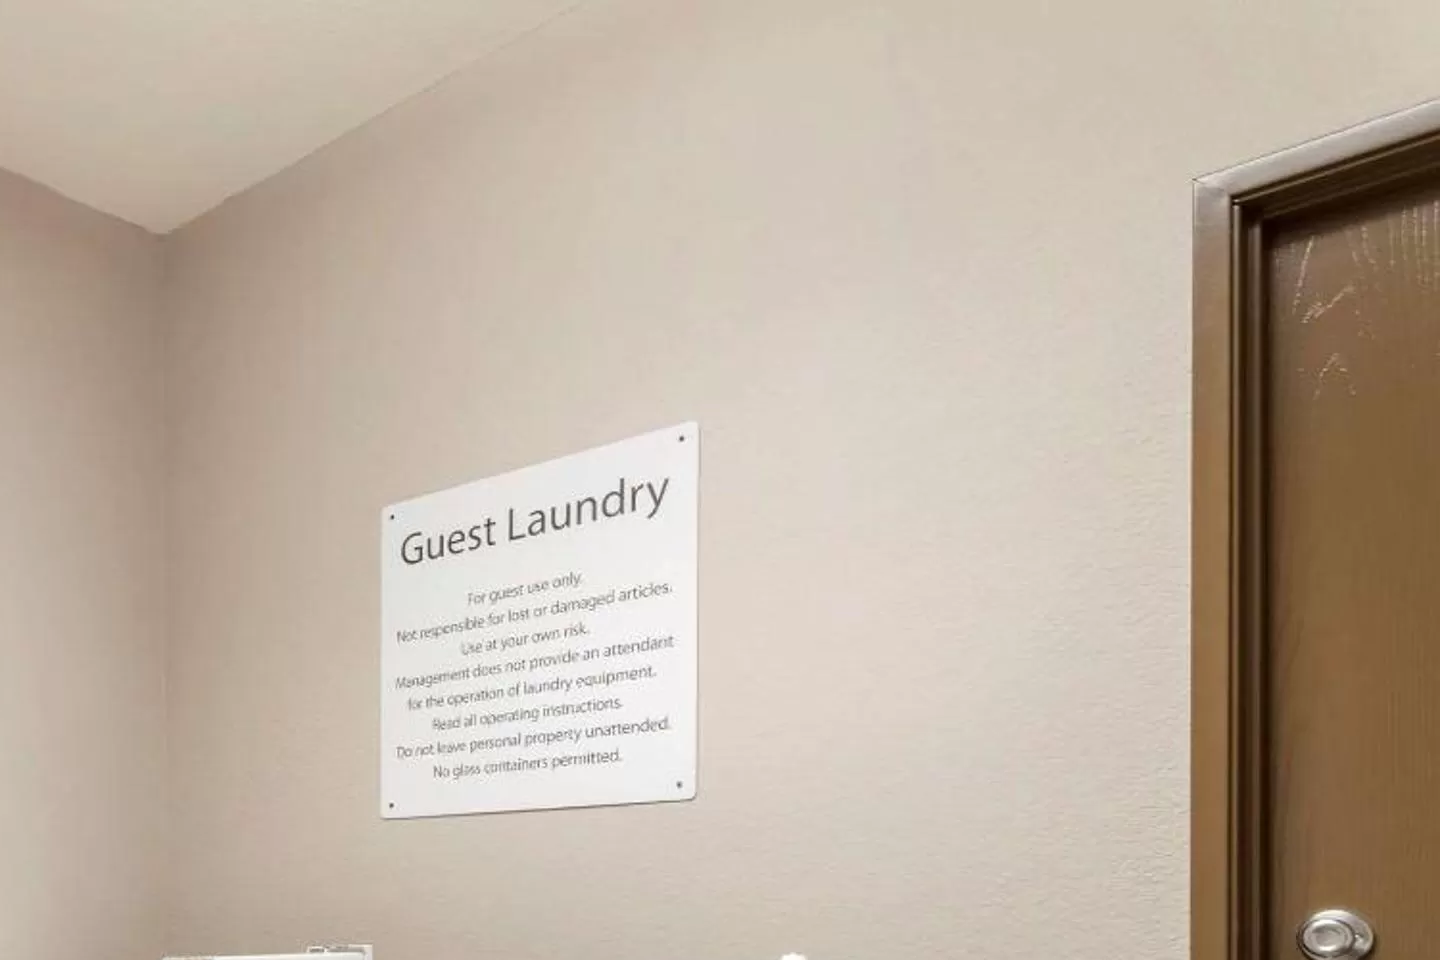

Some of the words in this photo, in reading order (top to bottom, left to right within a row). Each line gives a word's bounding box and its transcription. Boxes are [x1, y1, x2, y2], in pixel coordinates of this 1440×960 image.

[400, 517, 497, 566] Guest
[508, 477, 670, 541] Laundry
[396, 629, 418, 642] Not
[420, 617, 485, 639] responsible
[487, 612, 506, 625] for
[508, 608, 529, 622] lost
[533, 605, 548, 617] or
[550, 590, 615, 615] damaged
[617, 581, 673, 602] articles.
[467, 593, 487, 605] For
[489, 585, 524, 605] guest
[527, 580, 549, 594] use
[461, 642, 482, 655] Use
[485, 639, 498, 652] at
[500, 634, 529, 652] your
[531, 628, 560, 643] own
[563, 621, 590, 638] risk.
[395, 668, 470, 689] Management
[472, 664, 502, 678] does
[505, 659, 526, 672] not
[529, 648, 580, 672] provide
[583, 648, 600, 661] an
[602, 635, 674, 659] attendant
[408, 697, 423, 711] for
[426, 694, 445, 708] the
[447, 687, 504, 707] operation
[507, 681, 521, 697] of
[523, 676, 572, 694] laundry
[575, 665, 657, 690] equipment.
[432, 717, 461, 731] Read
[463, 713, 477, 728] all
[479, 707, 540, 728] operating
[542, 698, 624, 717] instructions.
[396, 746, 413, 759] Do
[415, 744, 434, 757] not
[437, 741, 467, 755] leave
[469, 732, 521, 754] personal
[524, 728, 582, 748] property
[584, 717, 670, 739] unattended.
[433, 764, 451, 778] No
[452, 762, 481, 780] glass
[483, 757, 549, 774] containers
[551, 747, 623, 770] permitted.
